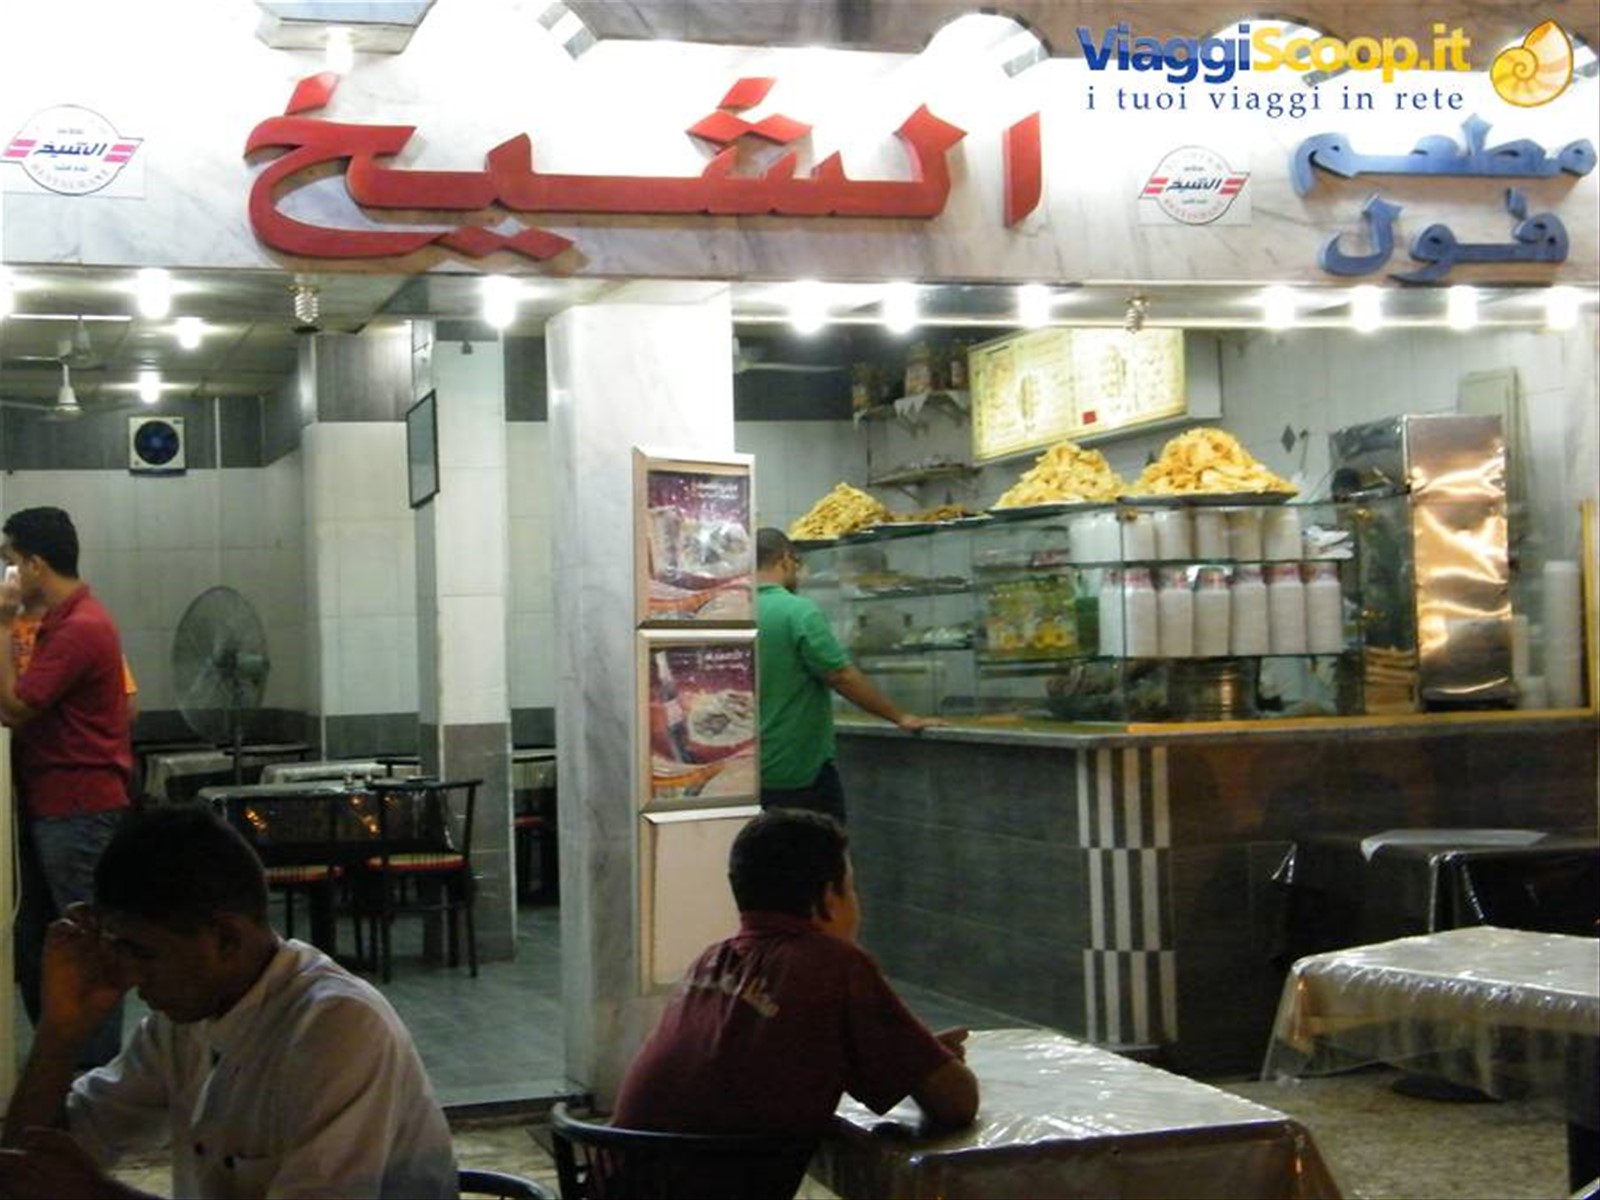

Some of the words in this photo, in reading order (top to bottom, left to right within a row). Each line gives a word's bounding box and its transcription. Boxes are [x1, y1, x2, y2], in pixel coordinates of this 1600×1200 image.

[33, 141, 107, 158] الشيخ
[243, 72, 1044, 262] الشيخ
[1290, 113, 1597, 200] مطعم
[1317, 188, 1570, 284] فول
